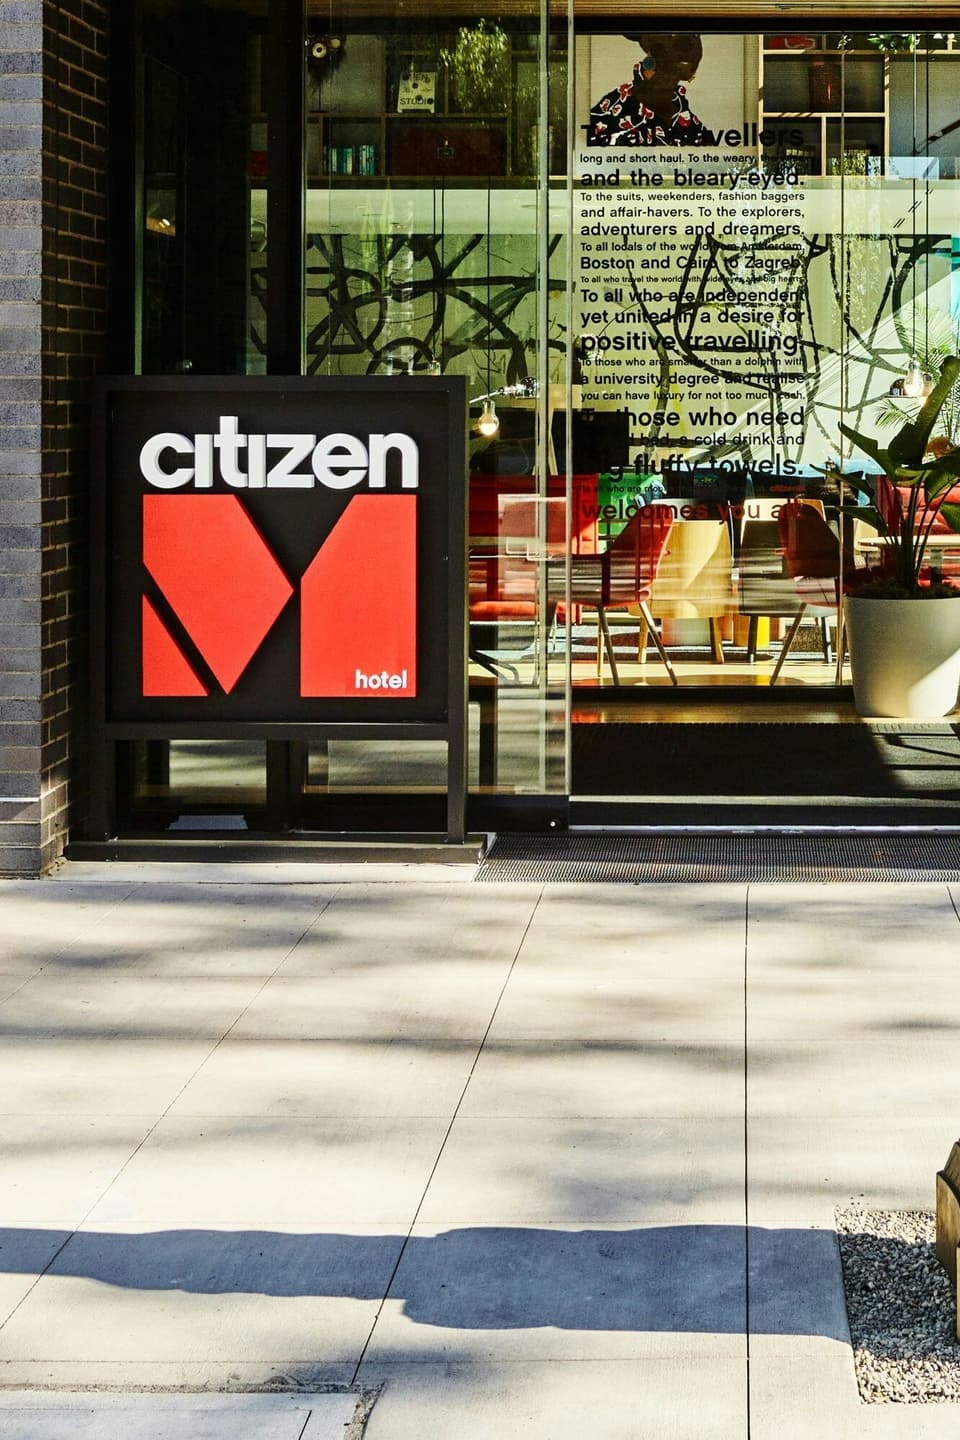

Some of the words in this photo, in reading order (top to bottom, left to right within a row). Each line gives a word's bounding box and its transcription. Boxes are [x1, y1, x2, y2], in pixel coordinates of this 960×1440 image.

[672, 123, 804, 147] vellers
[580, 154, 602, 165] long
[606, 154, 626, 162] and
[630, 154, 656, 162] short
[660, 154, 684, 162] haul.
[688, 154, 700, 162] To
[703, 154, 719, 162] the
[723, 154, 757, 165] weary,
[581, 168, 620, 186] and
[630, 168, 664, 186] the
[674, 168, 804, 190] bleary-eyed.
[580, 192, 592, 201] To
[596, 192, 612, 201] the
[617, 192, 644, 202] suits,
[648, 192, 715, 201] weekenders,
[719, 192, 757, 201] fashion
[761, 192, 805, 203] baggers
[581, 206, 605, 217] and
[610, 206, 693, 217] affair-havers.
[698, 206, 712, 217] To
[717, 206, 736, 217] the
[742, 206, 804, 219] explorers,
[581, 222, 677, 236] adventurers
[685, 222, 714, 236] and
[723, 222, 804, 236] dreamers.
[581, 242, 592, 251] To
[596, 242, 608, 251] all
[612, 242, 643, 251] locals
[646, 242, 656, 251] of
[660, 242, 676, 251] the
[680, 242, 708, 251] wold
[581, 256, 634, 269] Boston
[641, 256, 670, 269] and
[724, 256, 738, 269] to
[581, 288, 598, 302] To
[604, 288, 623, 302] all
[629, 288, 662, 302] who
[669, 288, 695, 302] are
[701, 288, 804, 305] independent
[581, 311, 608, 328] yet
[615, 308, 670, 323] united
[679, 308, 692, 323] in
[701, 308, 711, 323] a
[718, 308, 774, 323] desire
[780, 308, 804, 323] for
[581, 331, 676, 354] positive
[581, 357, 592, 366] To
[595, 357, 622, 366] those
[625, 357, 646, 366] who
[668, 357, 706, 366] smaer
[711, 357, 732, 366] than
[735, 357, 741, 366] a
[745, 357, 781, 368] dolphn
[785, 357, 804, 366] with
[581, 375, 589, 385] a
[594, 373, 664, 388] university
[669, 372, 719, 388] degree
[581, 393, 599, 402] you
[625, 391, 650, 400] have
[654, 391, 685, 402] luxury
[688, 391, 702, 400] for
[706, 391, 722, 400] not
[726, 391, 741, 400] too
[746, 391, 773, 400] much
[689, 407, 737, 426] who
[747, 407, 804, 426] need
[695, 433, 726, 445] cold
[732, 433, 770, 445] drink
[777, 433, 804, 445] and
[139, 416, 419, 489] citizen
[634, 453, 699, 479] fluffy
[709, 453, 803, 475] towels.
[355, 669, 408, 689] hotel
